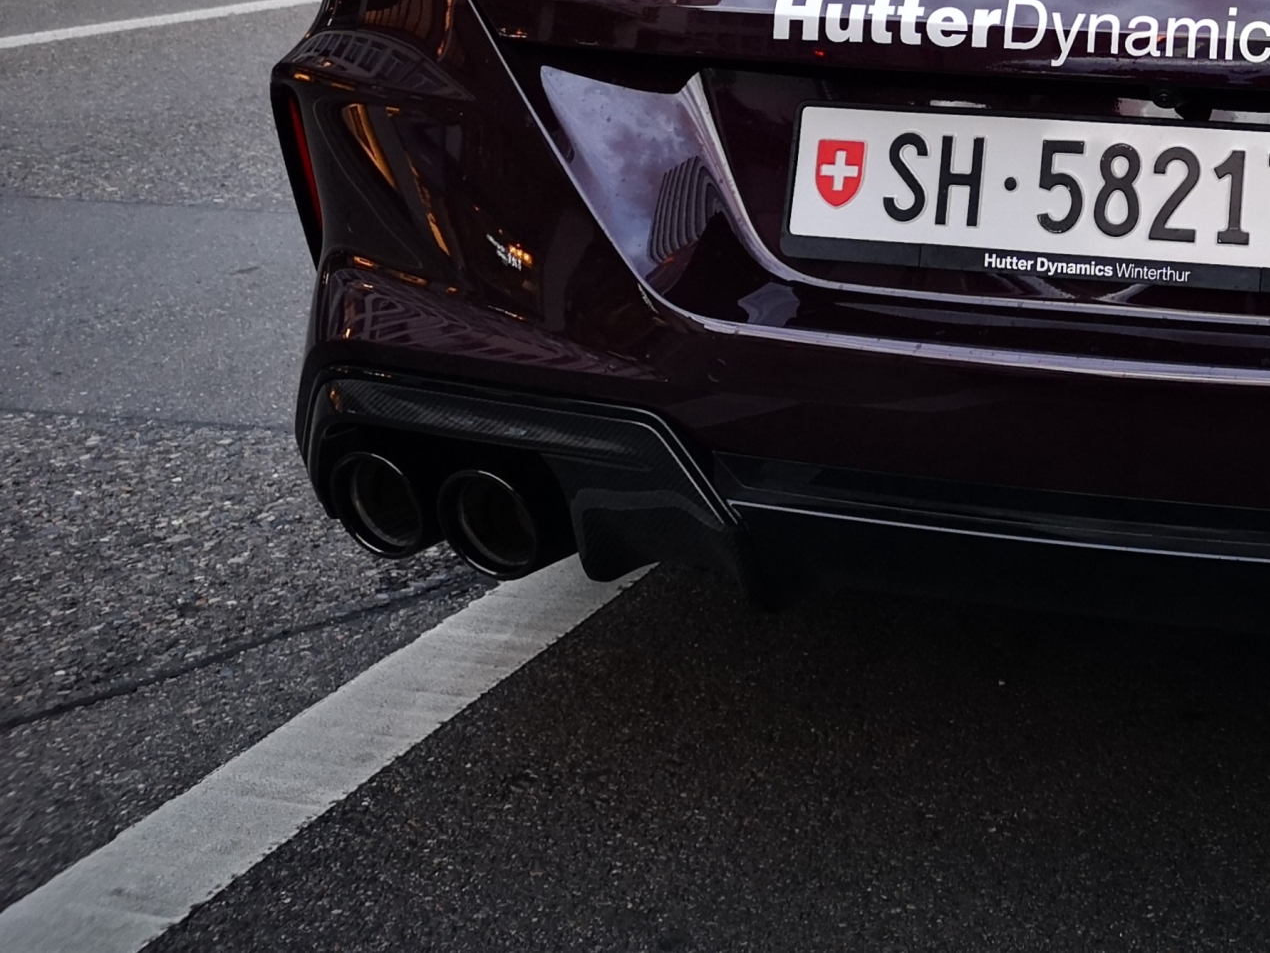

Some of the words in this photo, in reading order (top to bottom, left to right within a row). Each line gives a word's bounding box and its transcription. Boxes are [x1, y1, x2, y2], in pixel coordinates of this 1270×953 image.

[984, 253, 1034, 271] Hutter
[1036, 256, 1114, 277] Dynamics
[1116, 262, 1191, 283] Winterthur
